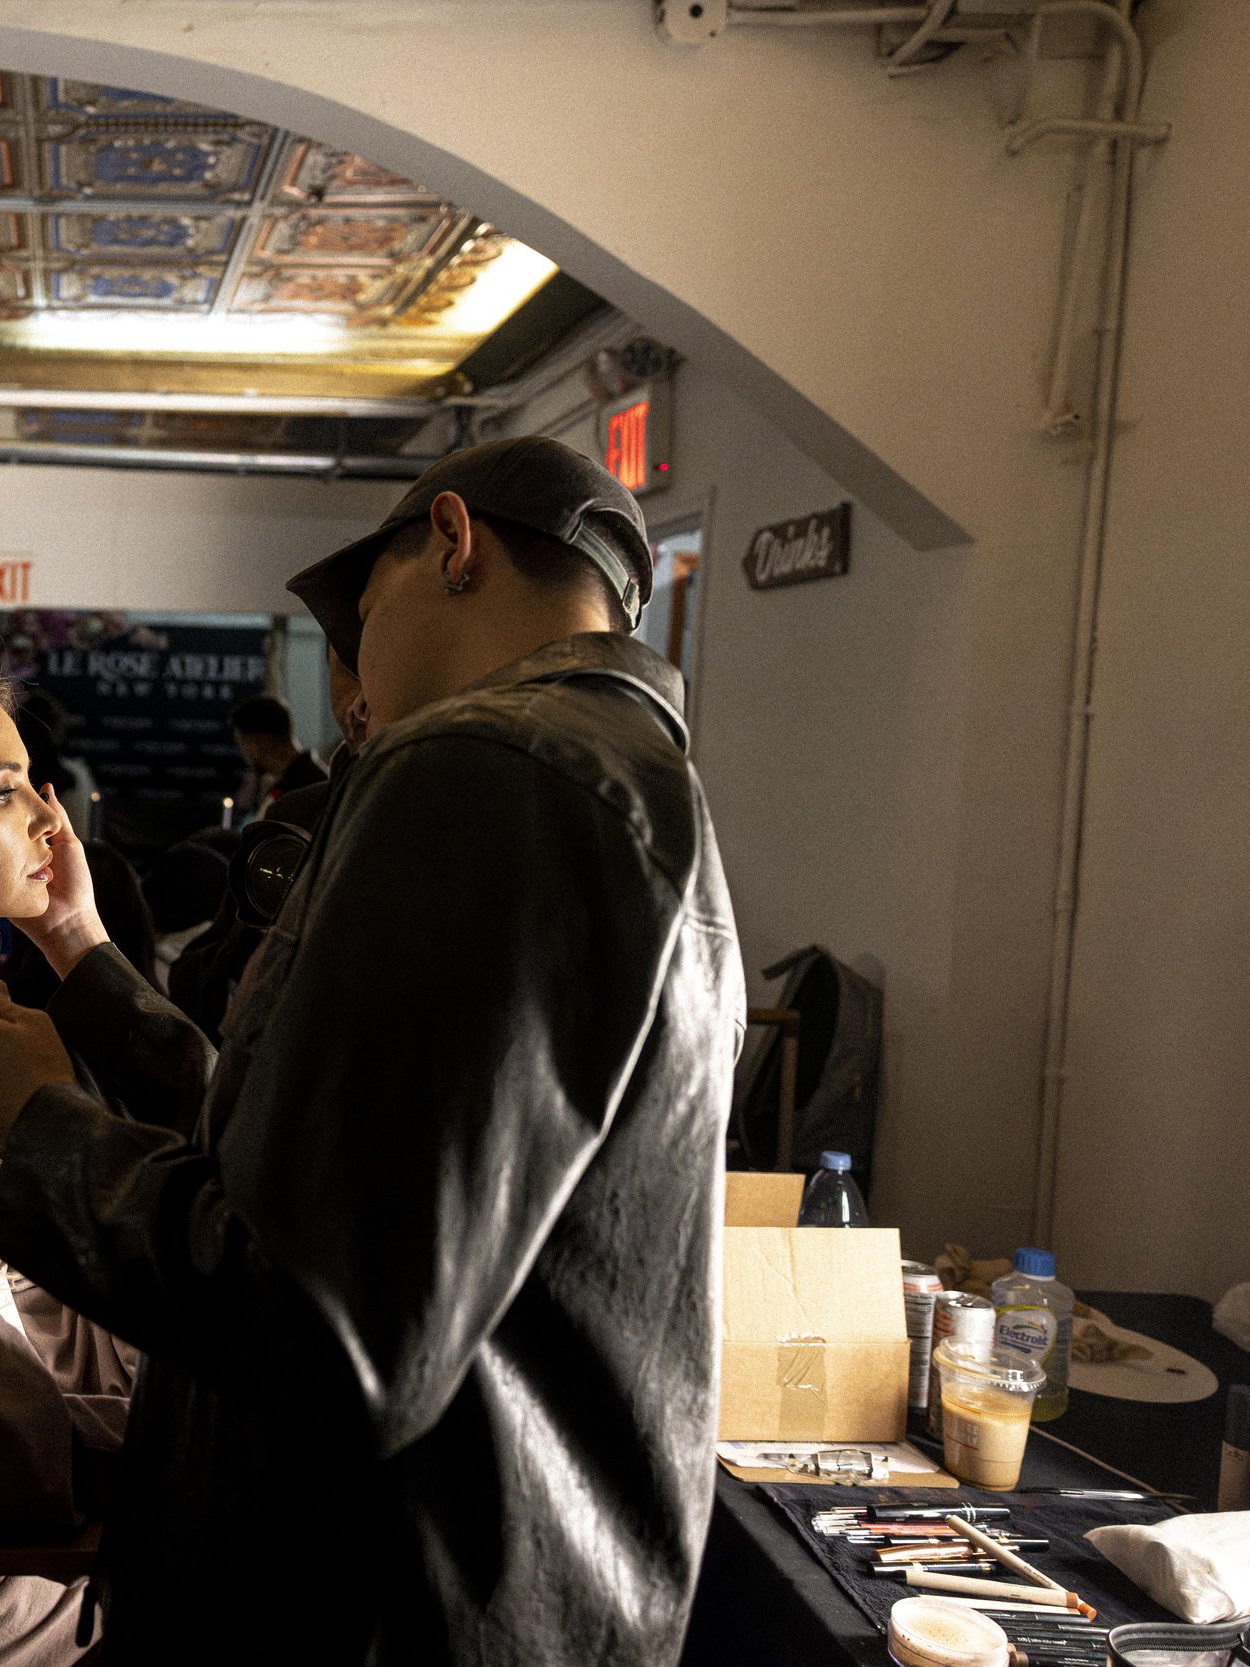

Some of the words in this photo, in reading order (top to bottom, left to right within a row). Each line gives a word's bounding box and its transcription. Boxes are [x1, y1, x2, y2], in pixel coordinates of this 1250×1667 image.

[753, 517, 833, 584] Drinks
[49, 650, 83, 677] LE
[87, 650, 159, 680] ROSE
[164, 682, 235, 700] YORK
[999, 1324, 1048, 1346] Electrolit
